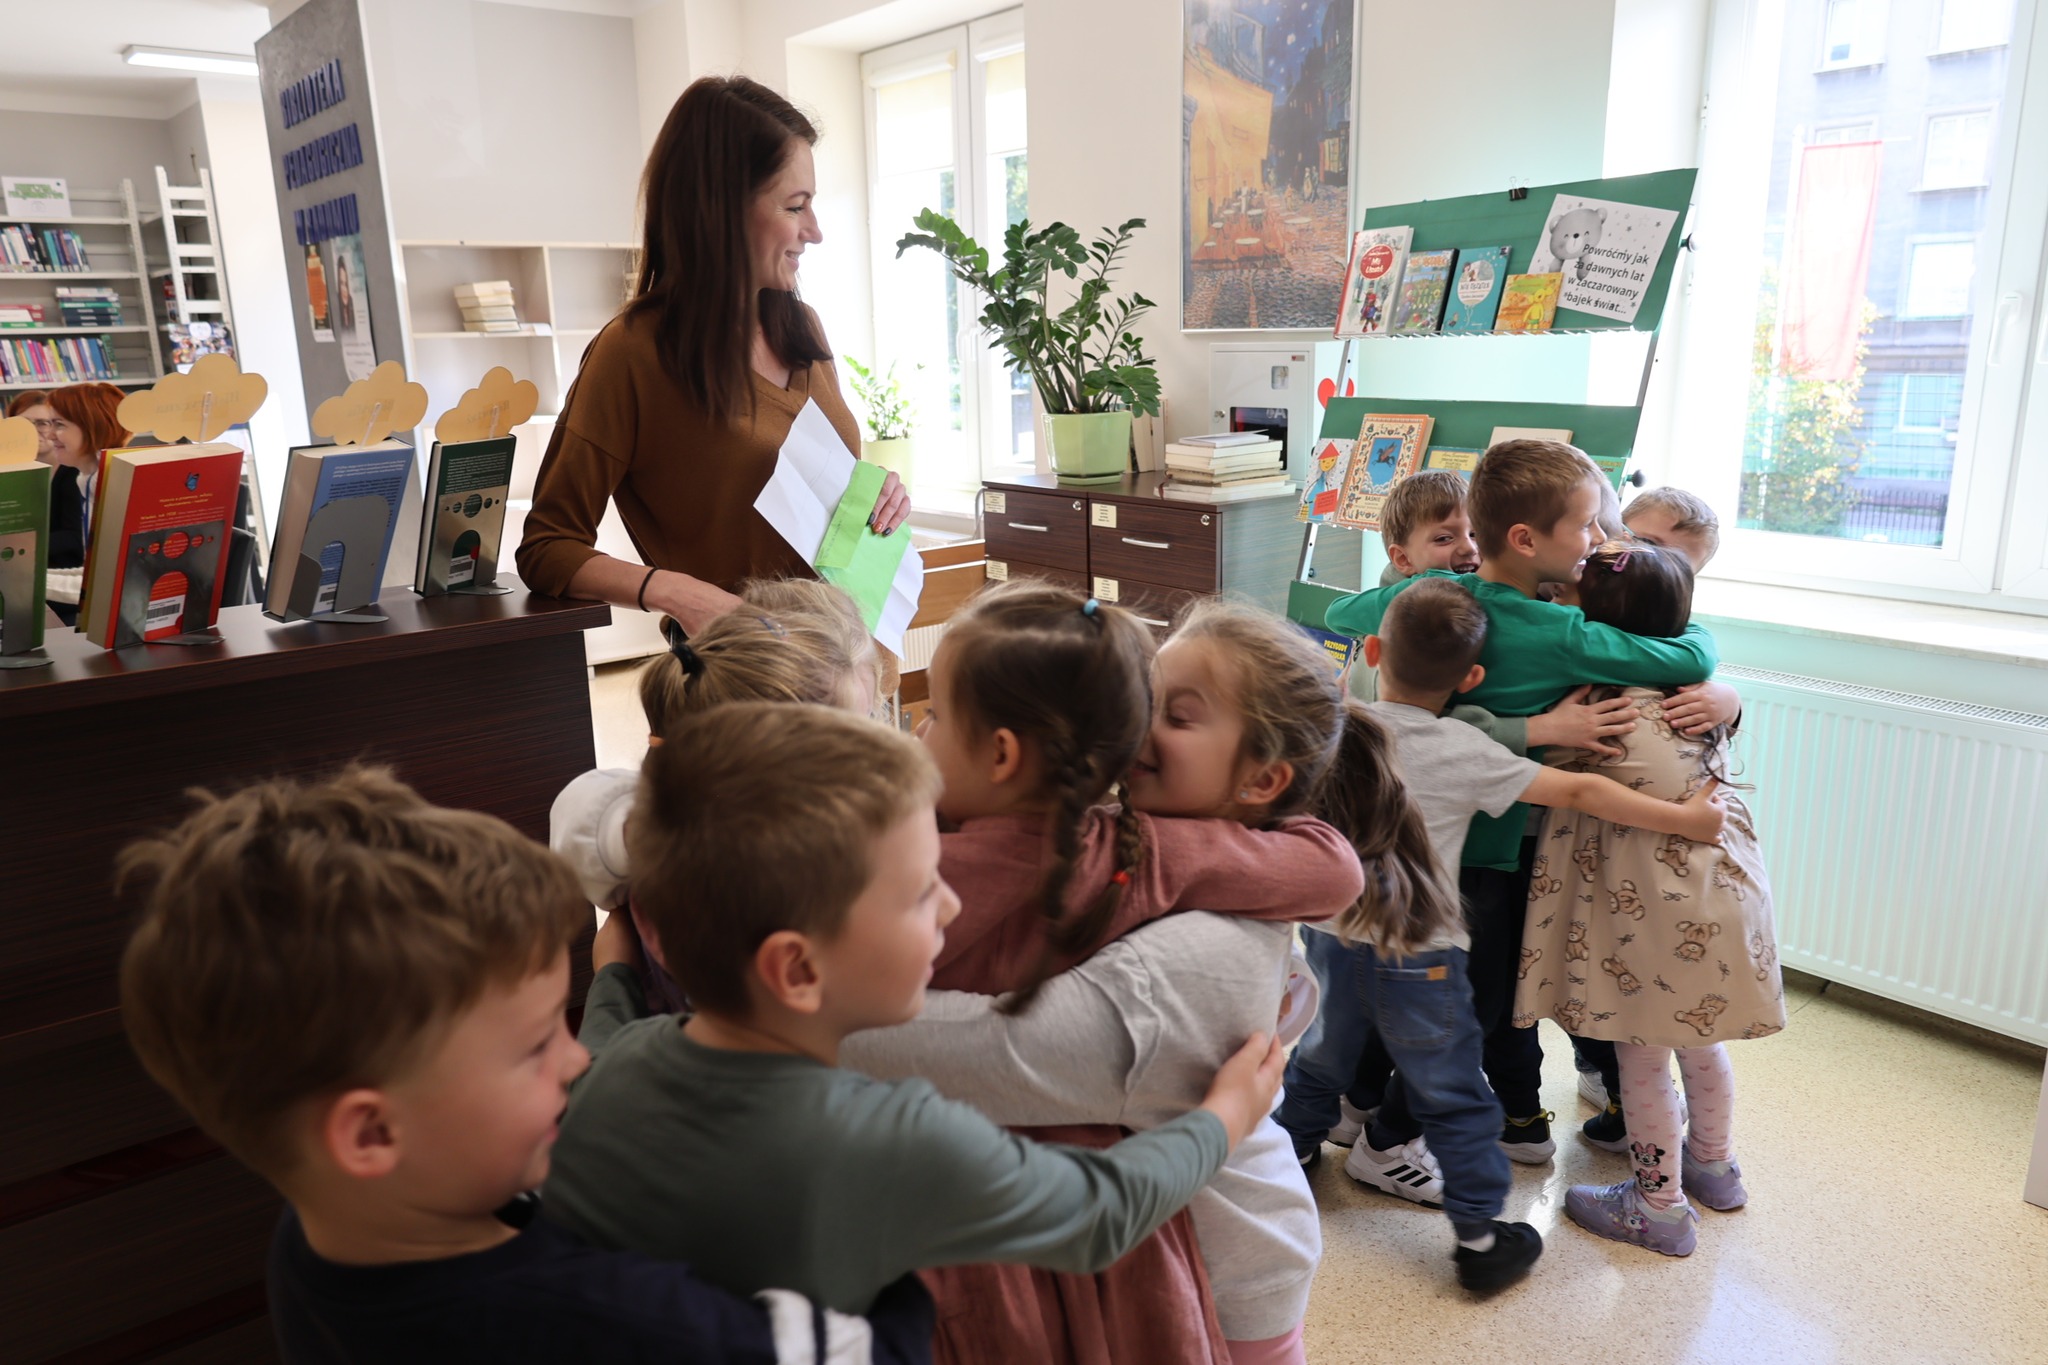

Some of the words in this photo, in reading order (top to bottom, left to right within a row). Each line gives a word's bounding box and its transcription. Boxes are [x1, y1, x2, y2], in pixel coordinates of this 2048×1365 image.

[280, 58, 345, 129] BIBLIOTEKA
[1582, 243, 1633, 264] Powróćmy
[1631, 252, 1650, 266] jak
[1574, 260, 1585, 270] za
[1585, 262, 1629, 279] dawnych
[1630, 270, 1645, 282] lat
[1566, 292, 1593, 306] bajek
[1567, 277, 1576, 285] w
[1576, 278, 1639, 301] zaczarowany
